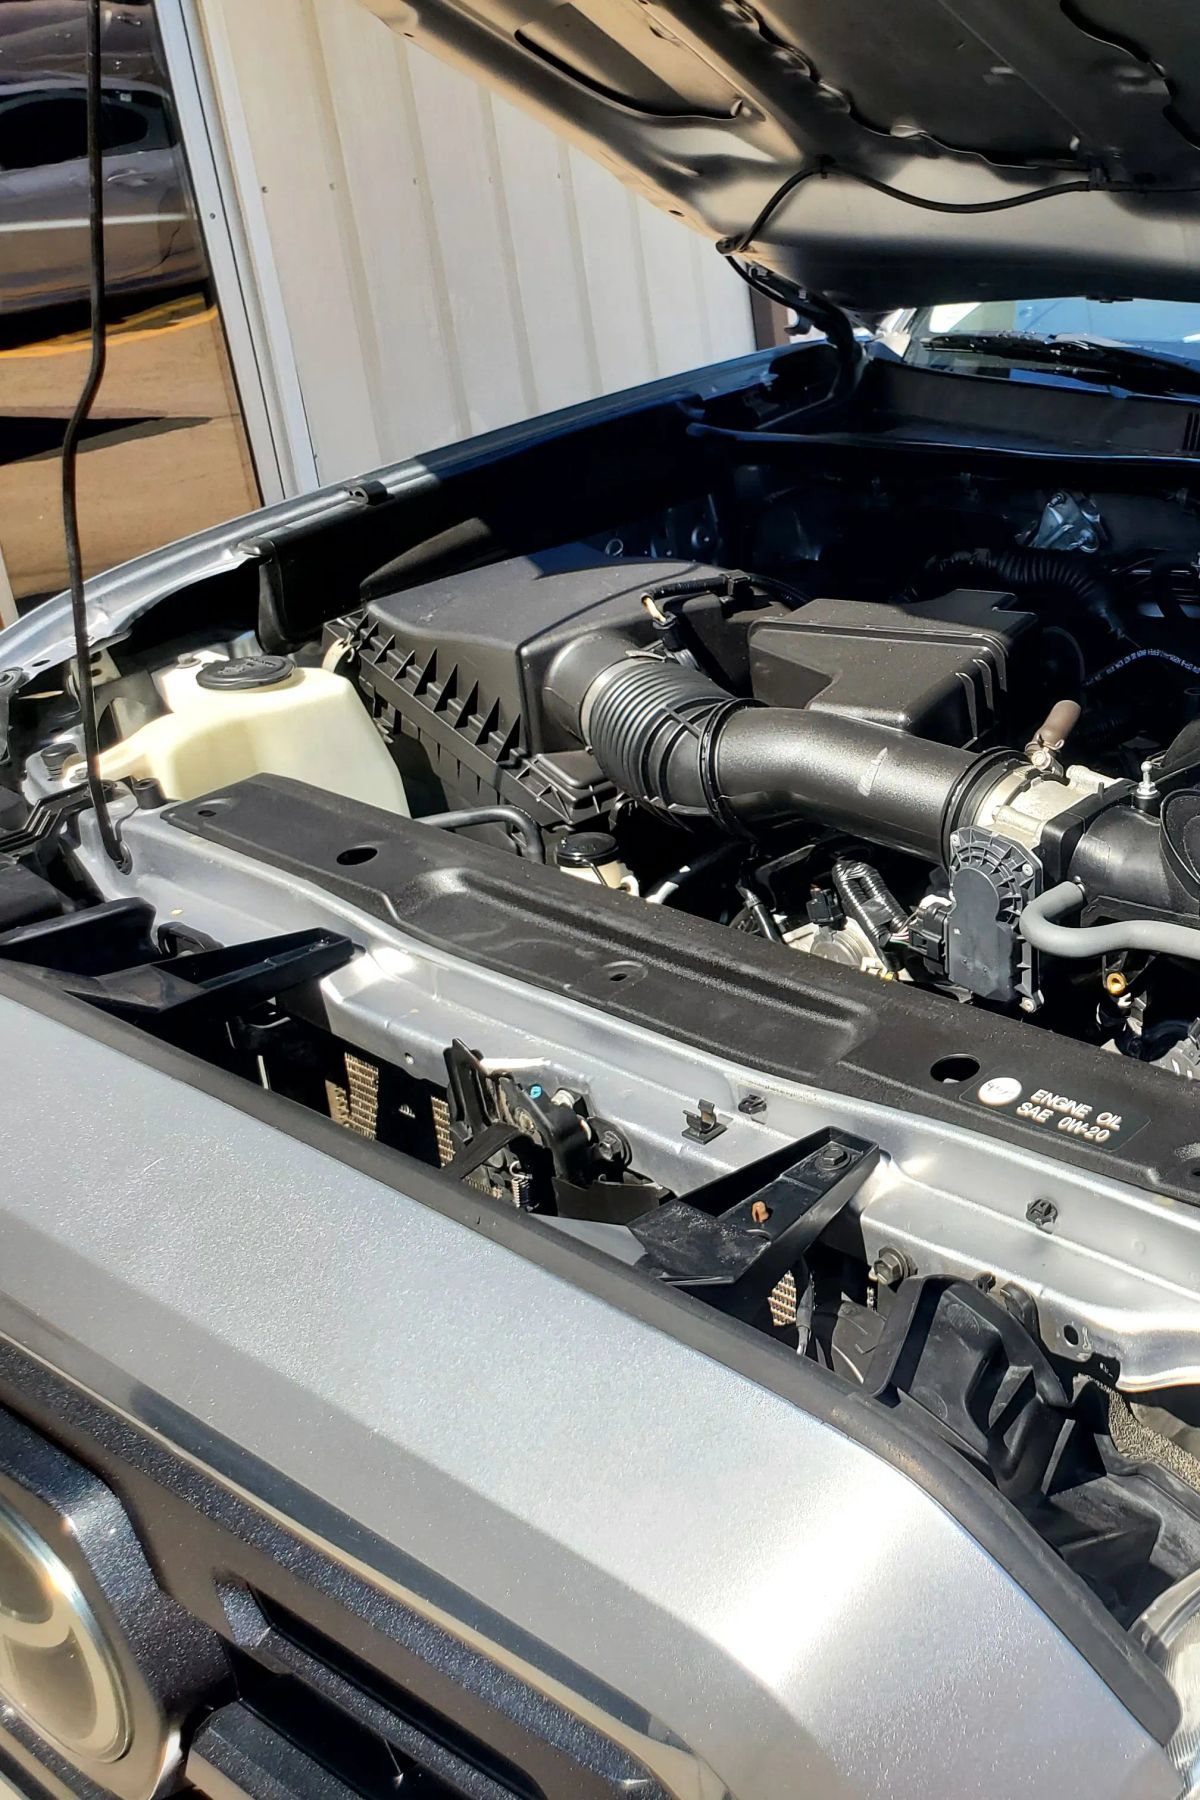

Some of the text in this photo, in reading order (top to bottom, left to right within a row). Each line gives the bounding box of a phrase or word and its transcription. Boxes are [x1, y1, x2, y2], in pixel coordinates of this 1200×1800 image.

[1016, 1102, 1110, 1142] SAE 0W-20
[1031, 1089, 1122, 1131] ENGINE OIL
